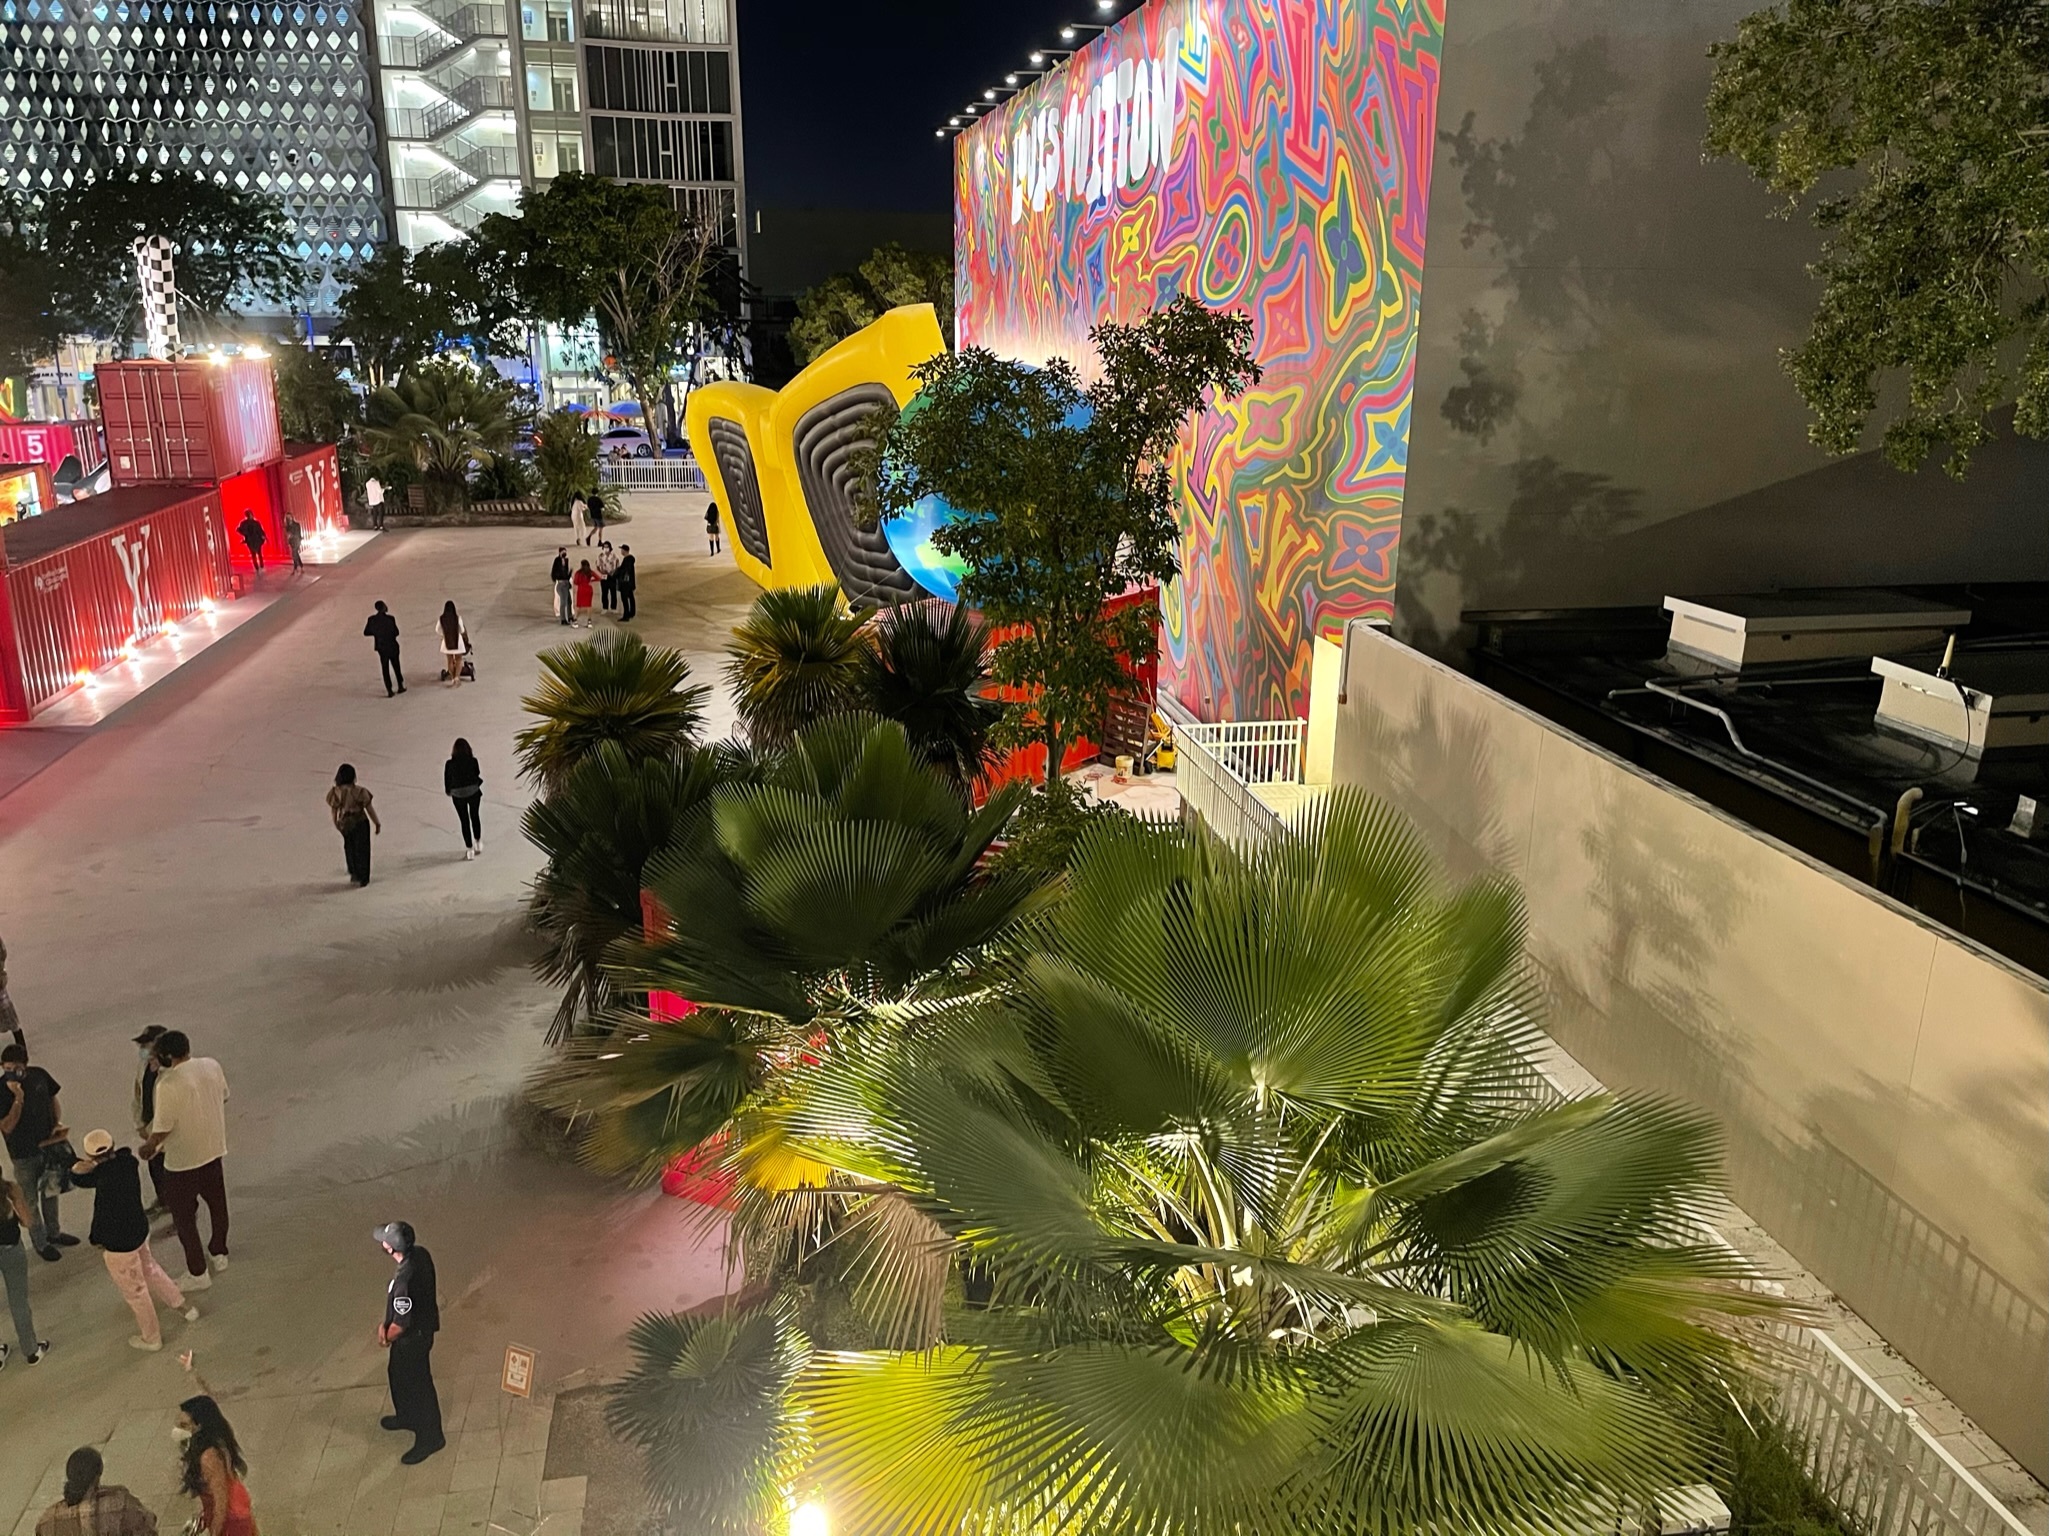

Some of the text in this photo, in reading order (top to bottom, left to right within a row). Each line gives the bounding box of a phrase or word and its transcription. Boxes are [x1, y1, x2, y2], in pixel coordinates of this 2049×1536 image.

[1011, 27, 1179, 226] LOUIS VUITTON
[27, 434, 44, 456] 5
